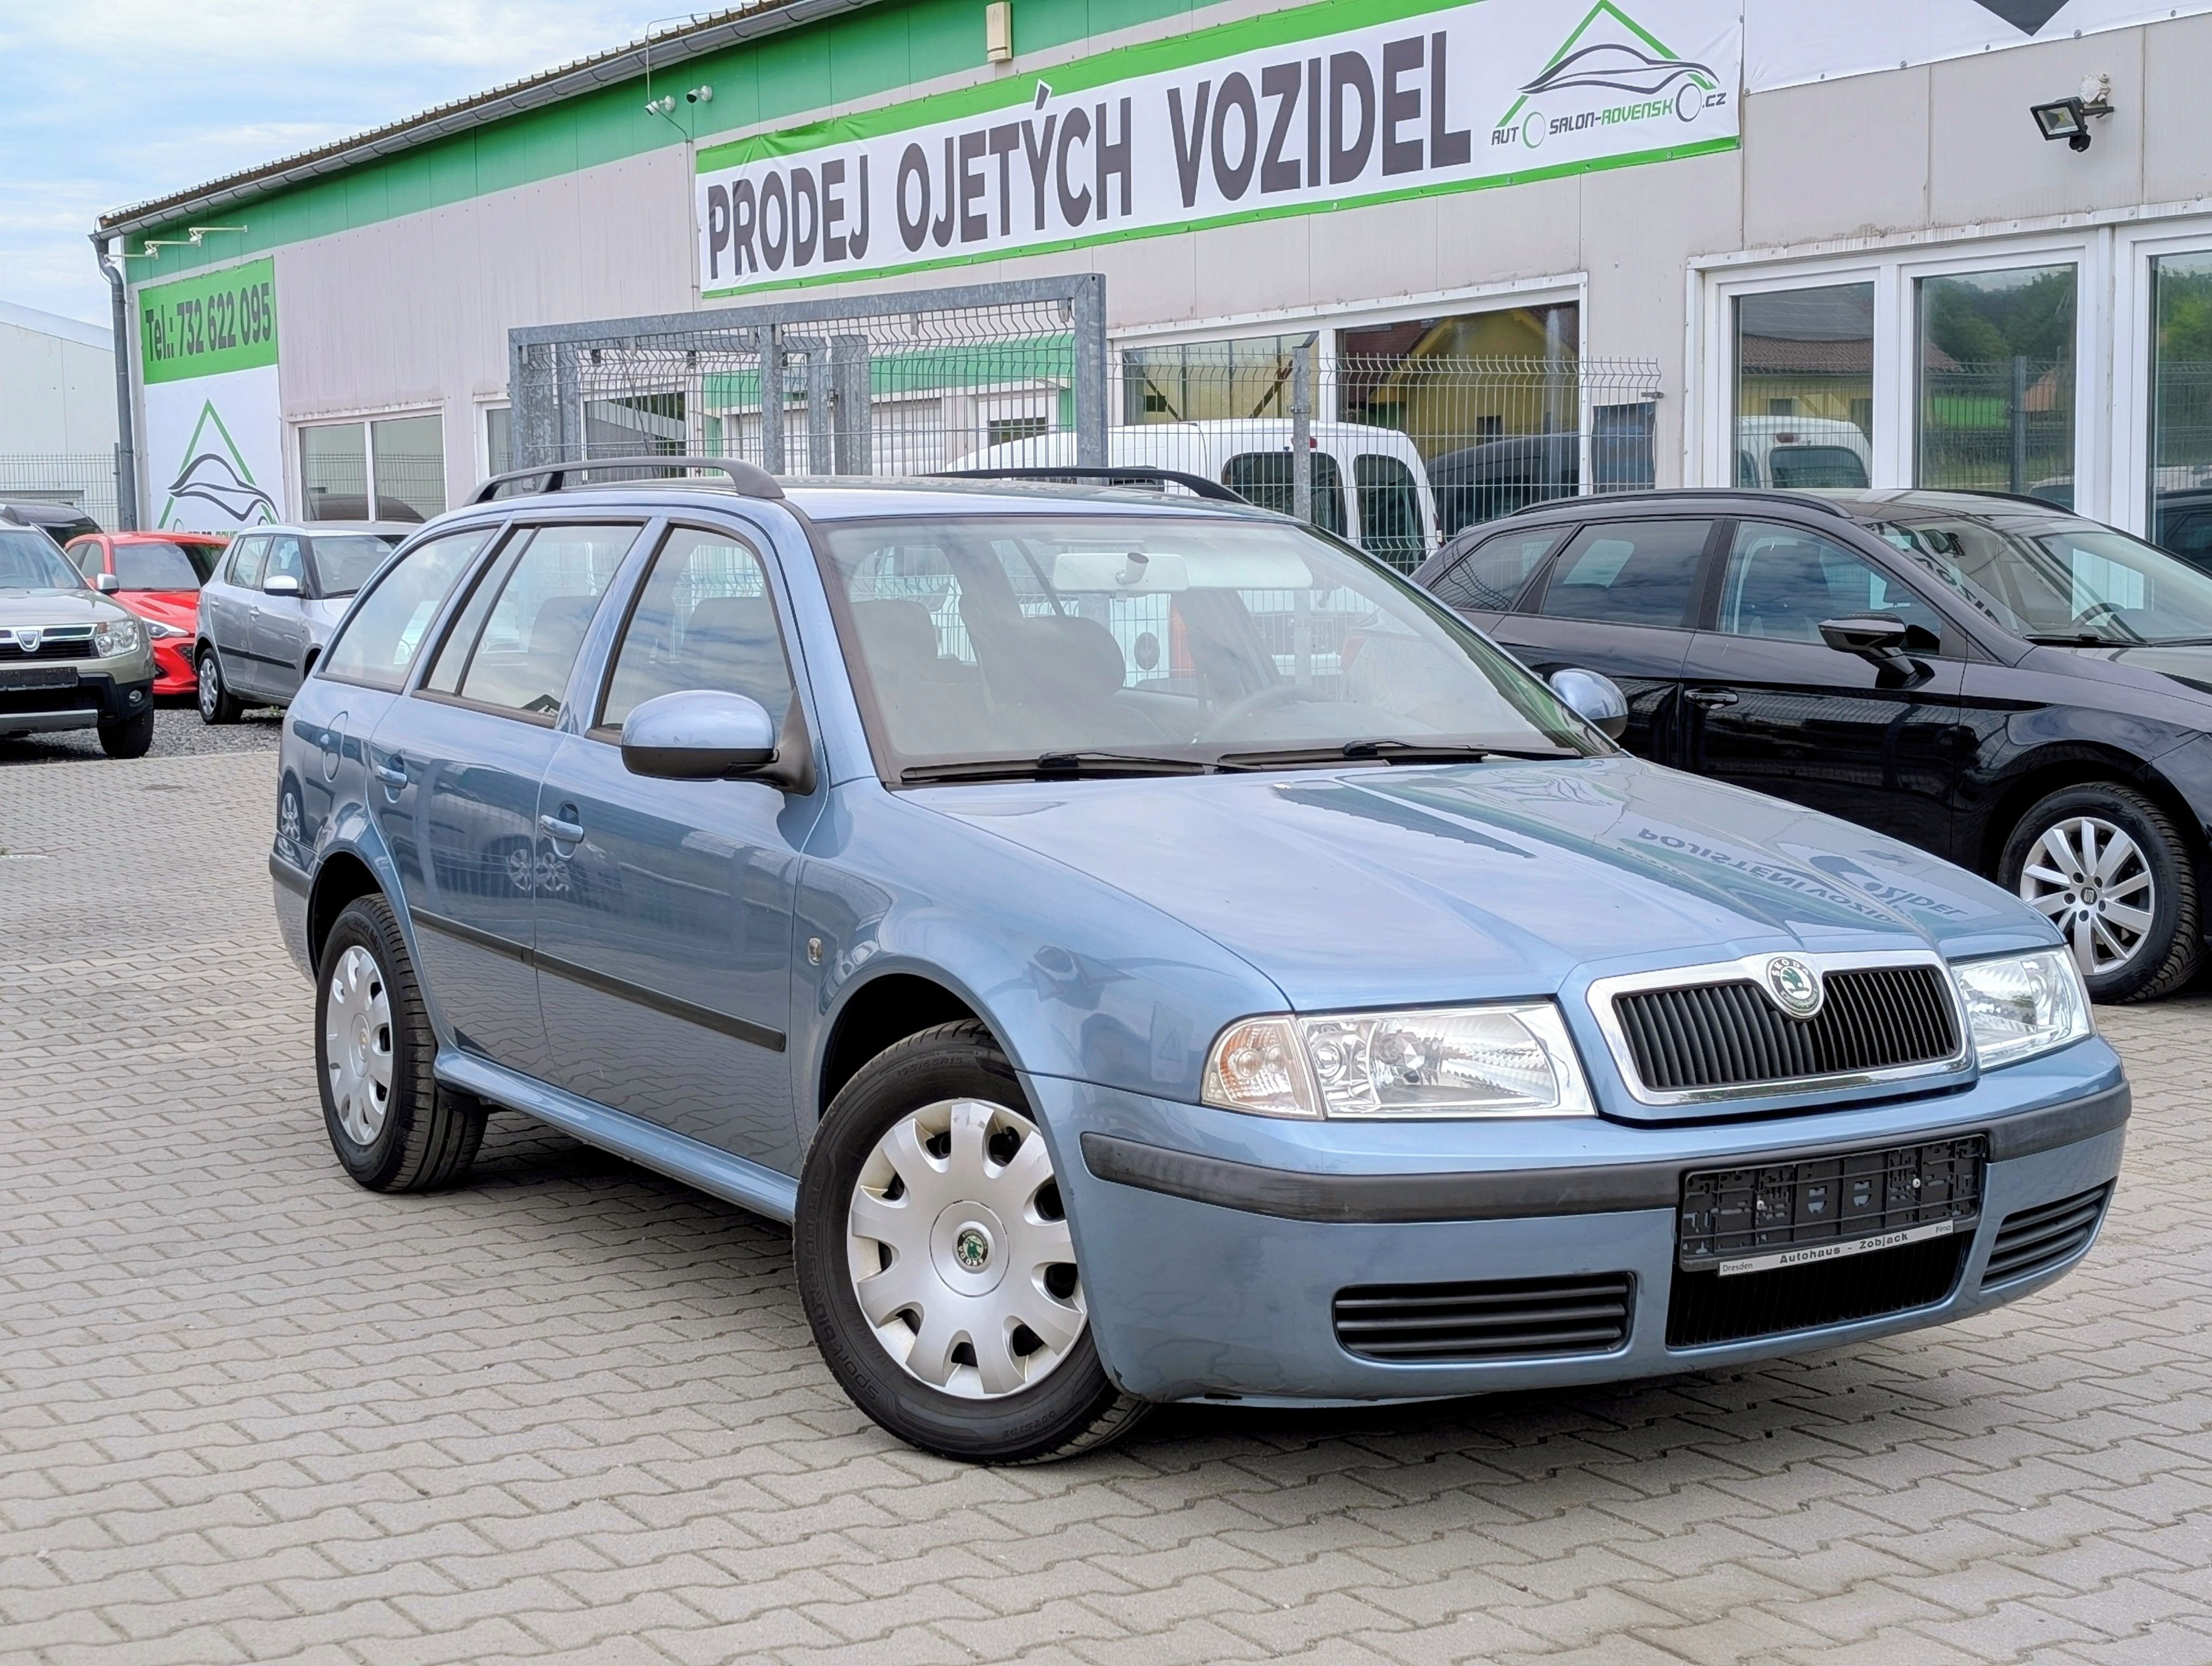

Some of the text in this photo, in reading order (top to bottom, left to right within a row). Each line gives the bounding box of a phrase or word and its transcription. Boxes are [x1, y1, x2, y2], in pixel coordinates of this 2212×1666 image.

[707, 30, 1471, 280] PRODEJ OJETÝCH VOZIDEL
[145, 282, 271, 362] Tel.: 732 622 095
[1722, 1261, 1753, 1272] Dresden
[1779, 1247, 1841, 1264] Autohaus
[1859, 1232, 1908, 1250] Zobjack
